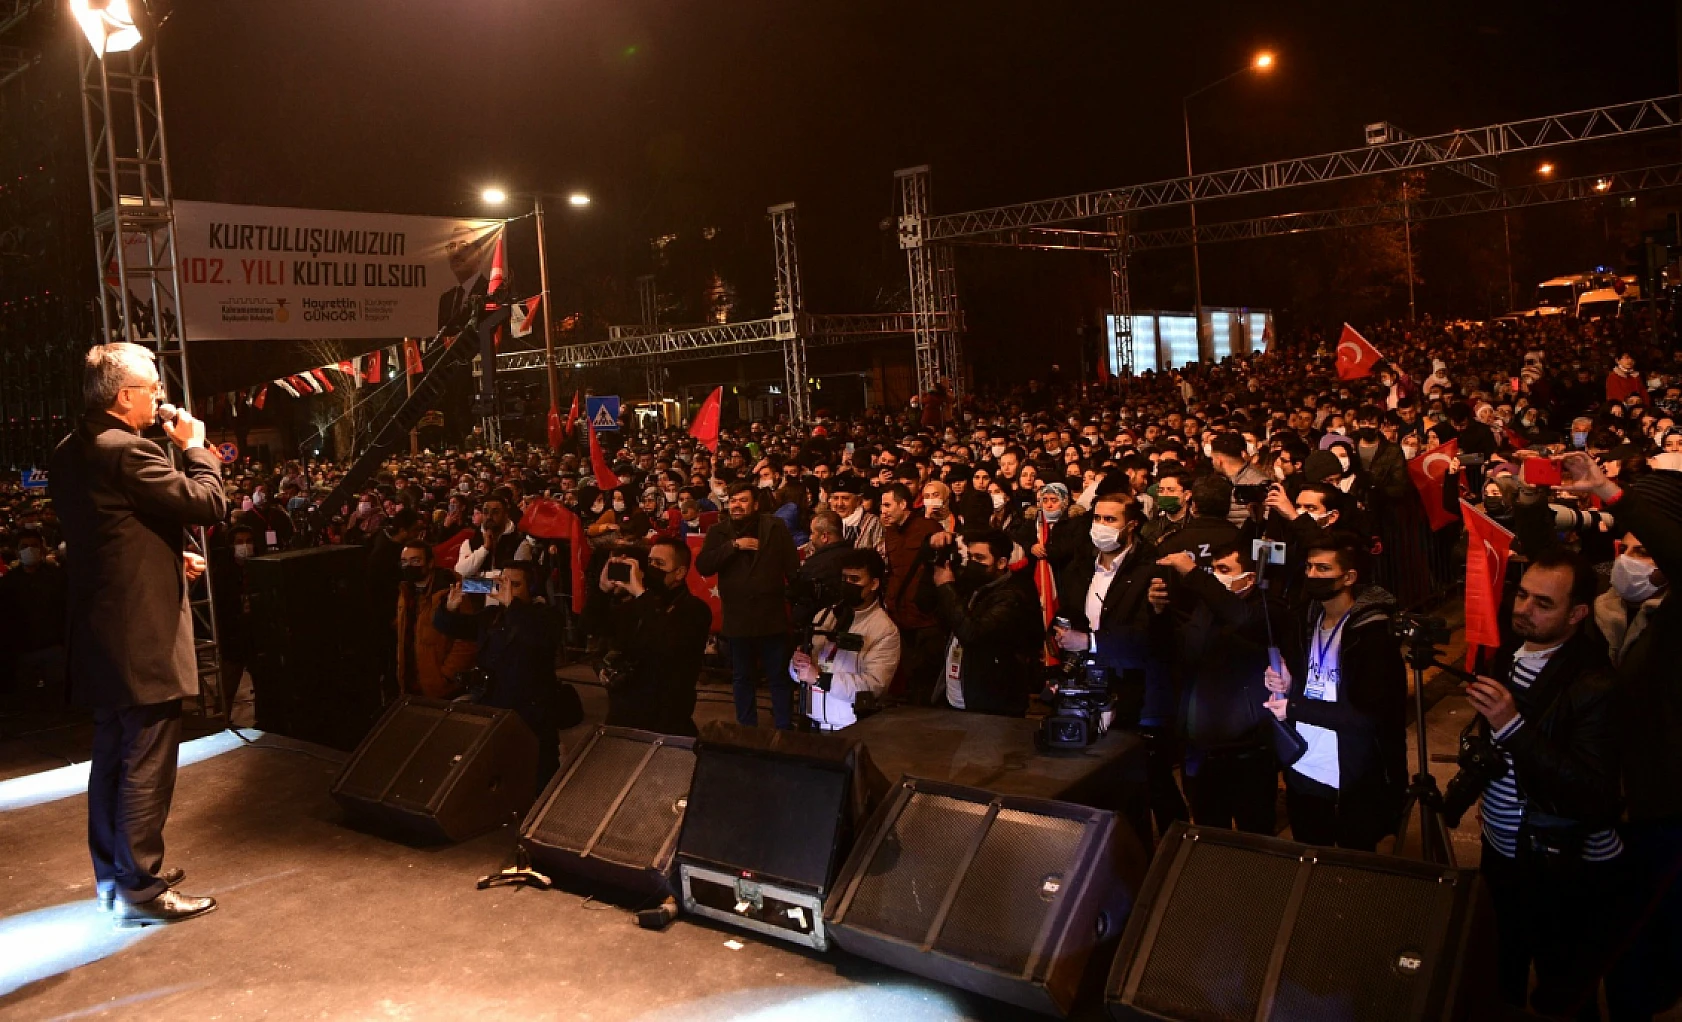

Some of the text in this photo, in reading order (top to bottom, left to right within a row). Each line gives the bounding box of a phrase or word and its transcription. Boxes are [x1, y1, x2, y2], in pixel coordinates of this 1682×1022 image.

[209, 222, 406, 258] KURTULUŞUMUZUN
[182, 257, 427, 288] 102. YILI KUTLU OLSUN
[302, 297, 357, 311] Hayrettin
[303, 308, 357, 322] GÜNGÖR
[1398, 956, 1422, 970] RCF
